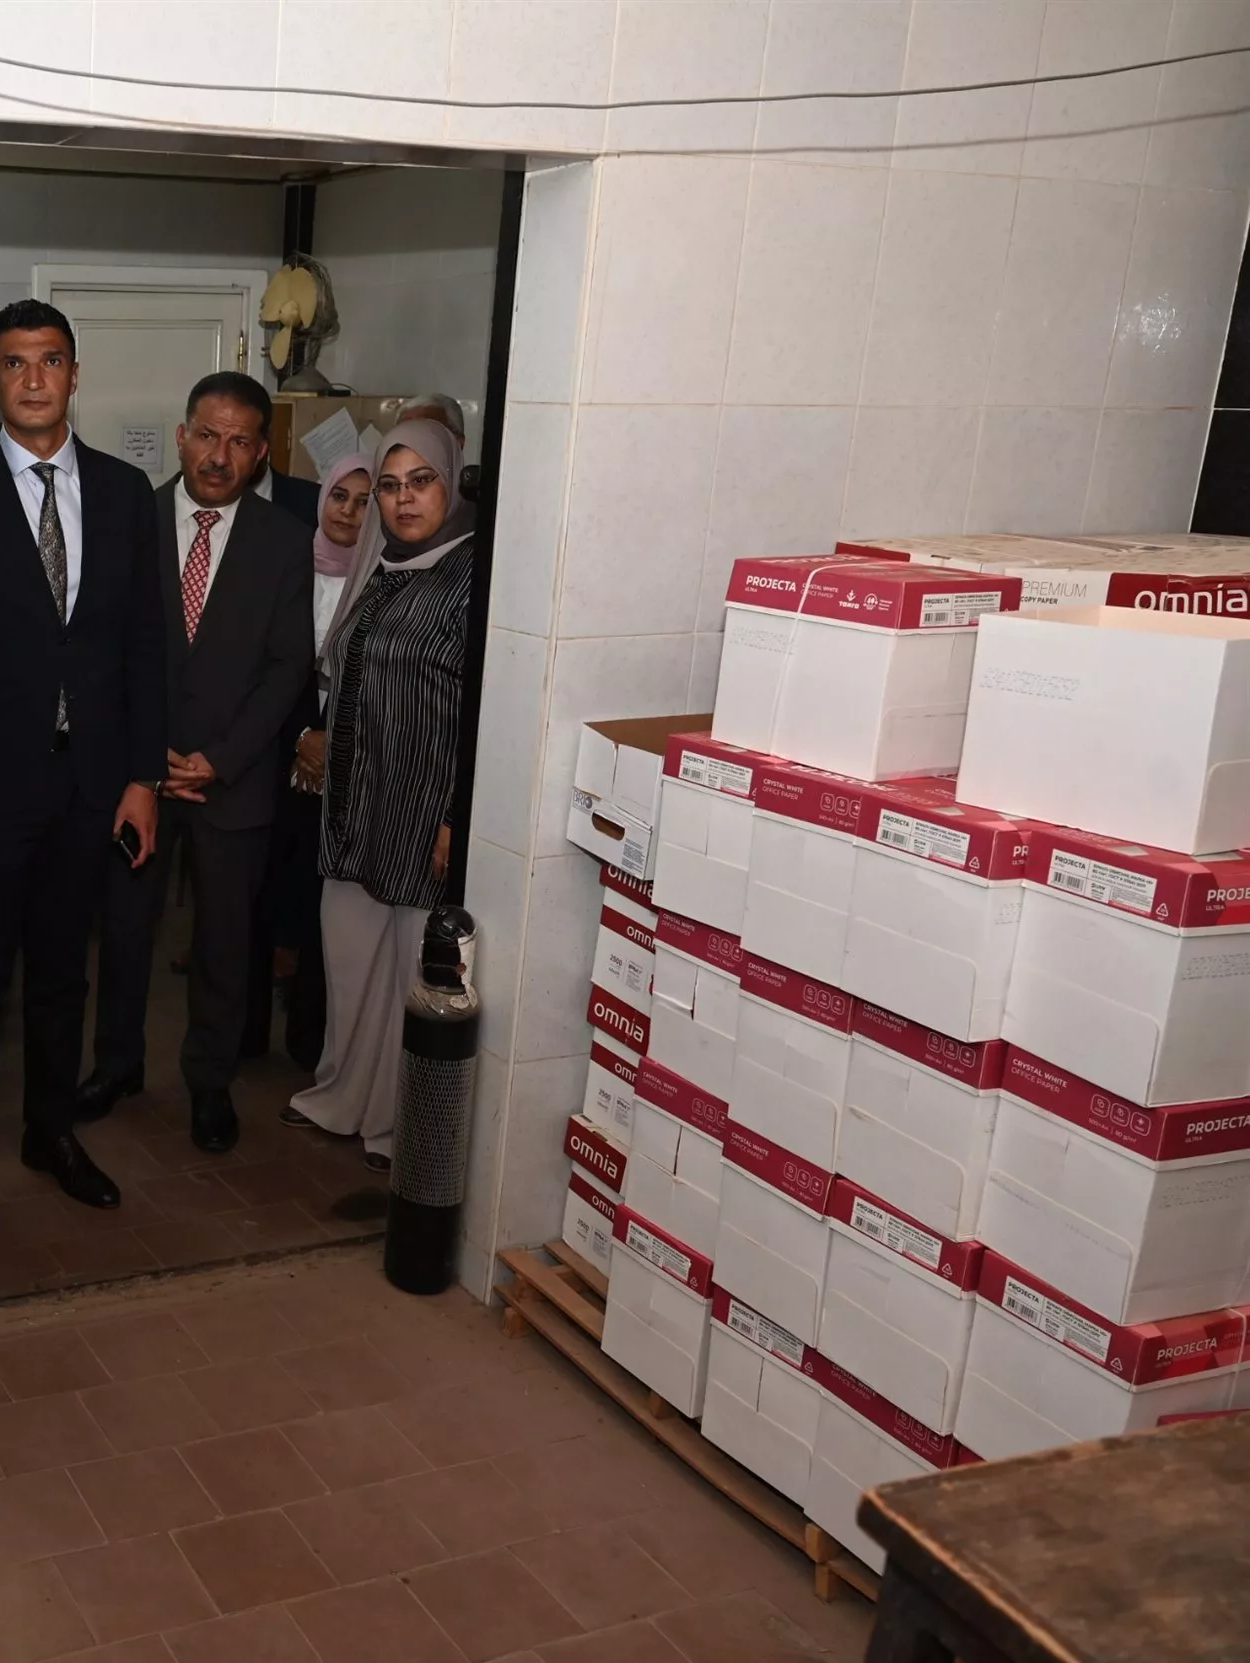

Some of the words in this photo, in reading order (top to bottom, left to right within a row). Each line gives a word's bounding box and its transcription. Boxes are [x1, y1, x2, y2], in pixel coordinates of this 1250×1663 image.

[746, 575, 797, 592] PROJECTA
[1022, 580, 1087, 598] PREMIUM
[1037, 597, 1058, 605] PAPER
[1134, 584, 1248, 614] omnia
[762, 786, 781, 797] OFFICE
[782, 791, 799, 801] PAPER
[763, 778, 785, 791] CRYSTAL
[786, 783, 804, 794] WHITE
[883, 814, 909, 827] PROJECTA
[1054, 855, 1086, 870] PROJECTA
[1207, 888, 1250, 903] PROJE
[747, 969, 765, 982] OFFICE
[765, 977, 782, 988] PAPER
[748, 961, 769, 976] CRYSTAL
[769, 969, 787, 983] WHITE
[594, 1002, 644, 1043] omnia
[862, 1010, 882, 1025] OFFICE
[882, 1020, 903, 1033] PAPER
[863, 1002, 887, 1021] CRYSTAL
[888, 1012, 908, 1027] WHITE
[1011, 1067, 1036, 1083] OFFICE
[1036, 1078, 1061, 1094] PAPER
[1012, 1058, 1043, 1077] CRYSTAL
[1044, 1072, 1068, 1088] WHITE
[1186, 1115, 1250, 1135] PROJECTA
[731, 1131, 751, 1148] CRYSTAL
[752, 1143, 770, 1157] WHITE
[570, 1134, 618, 1180] omnia
[591, 1195, 615, 1220] omn
[856, 1201, 883, 1220] PROJECTA
[1008, 1281, 1040, 1304] PROJECTA
[1156, 1337, 1218, 1361] PROJECTA
